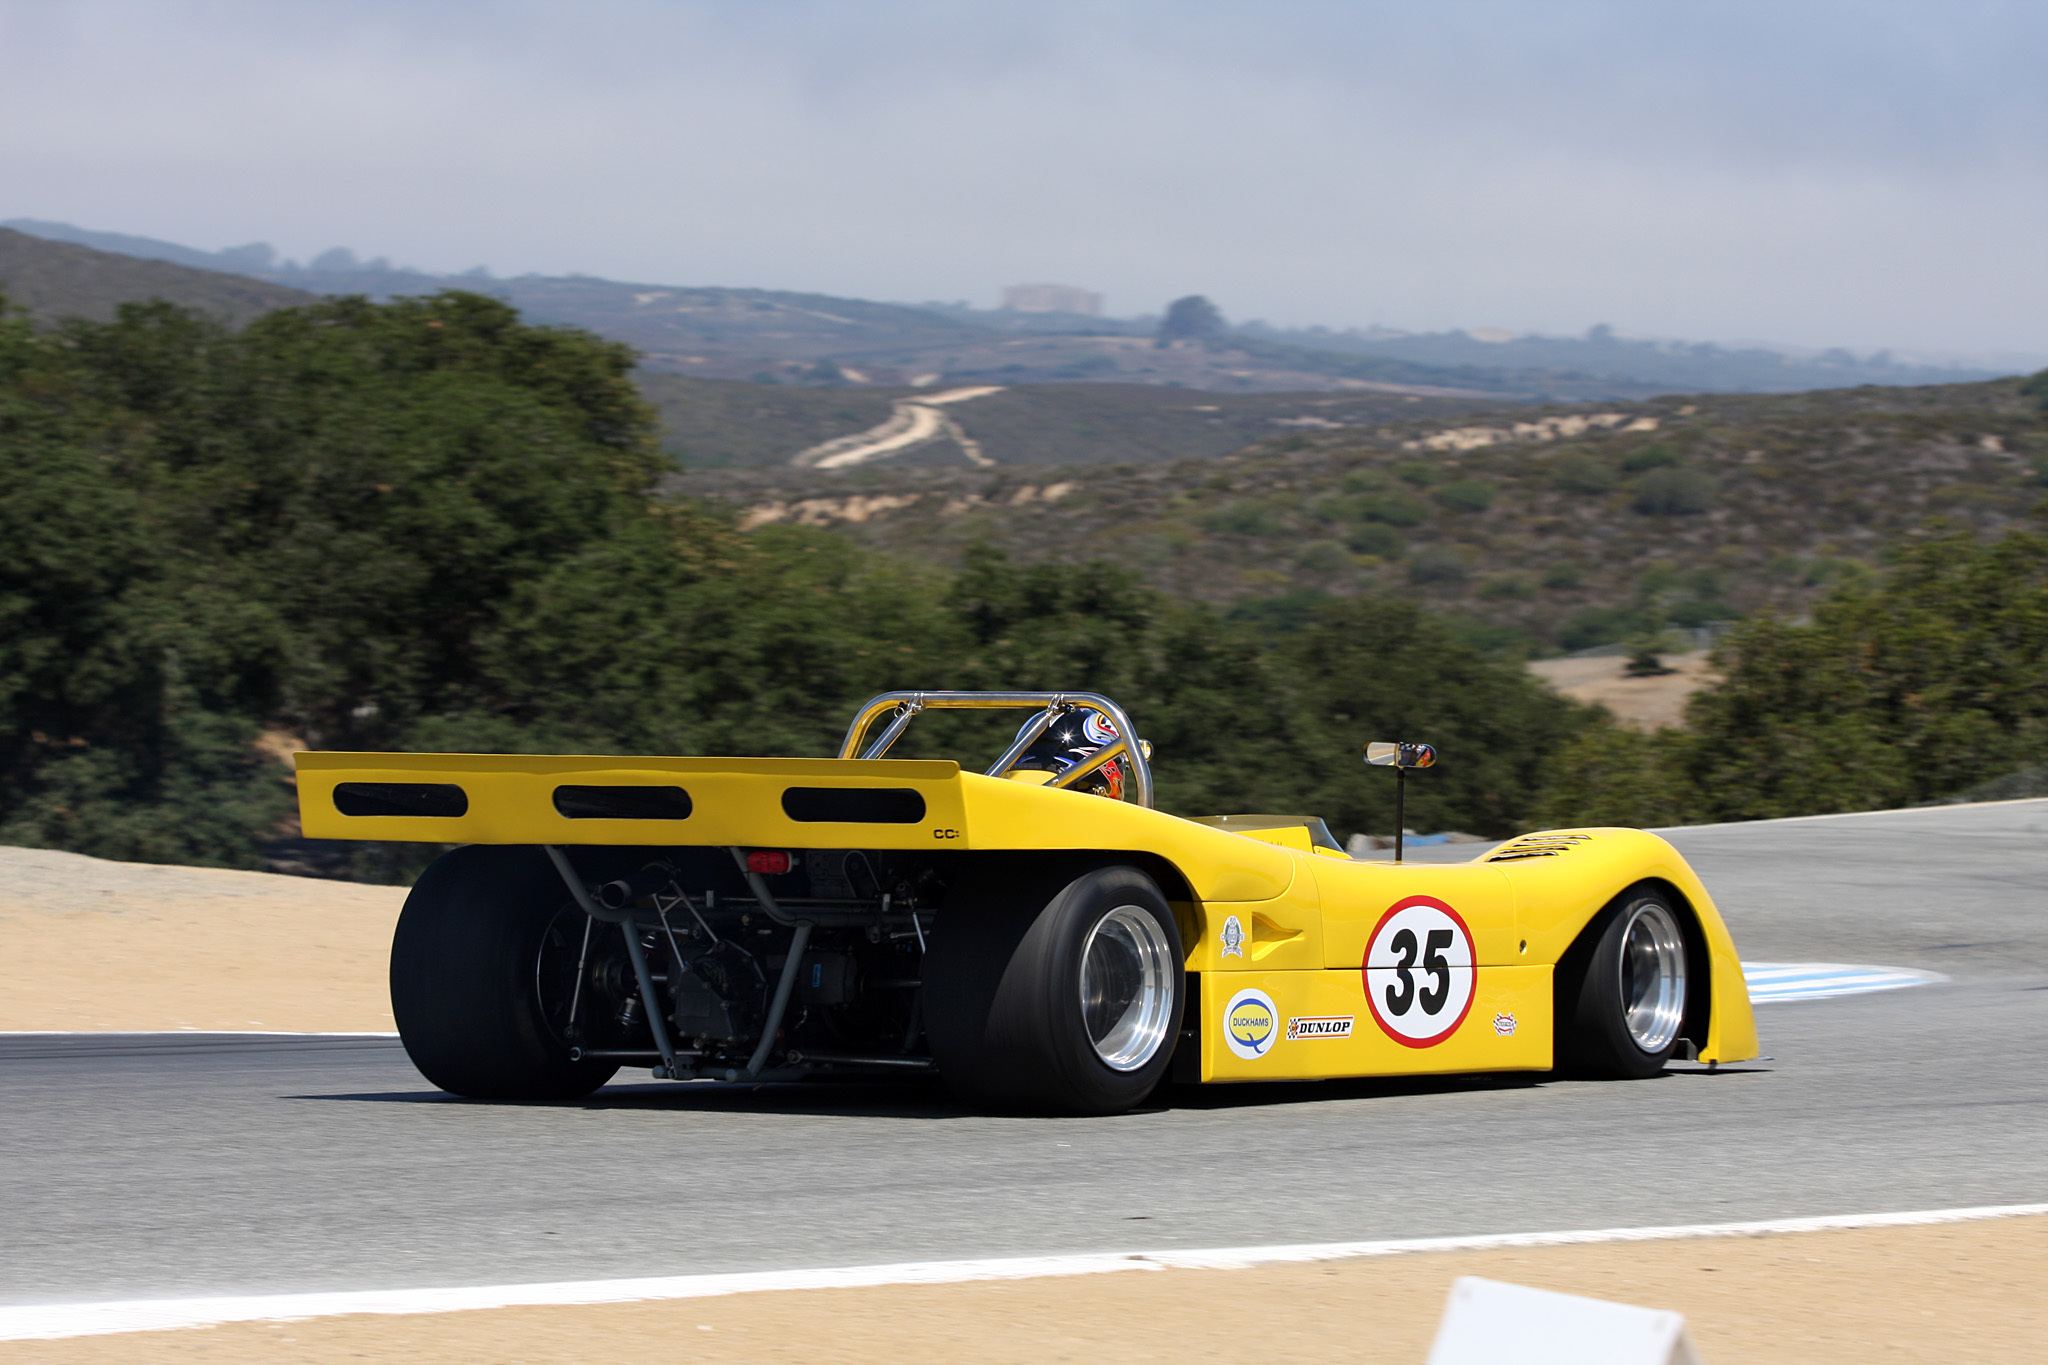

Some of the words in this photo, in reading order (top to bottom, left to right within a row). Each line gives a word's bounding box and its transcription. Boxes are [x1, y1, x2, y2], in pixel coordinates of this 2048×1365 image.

[1386, 928, 1454, 1017] 35
[1233, 1017, 1269, 1027] DUCKHAMS
[1299, 1021, 1351, 1034] DUNLOP
